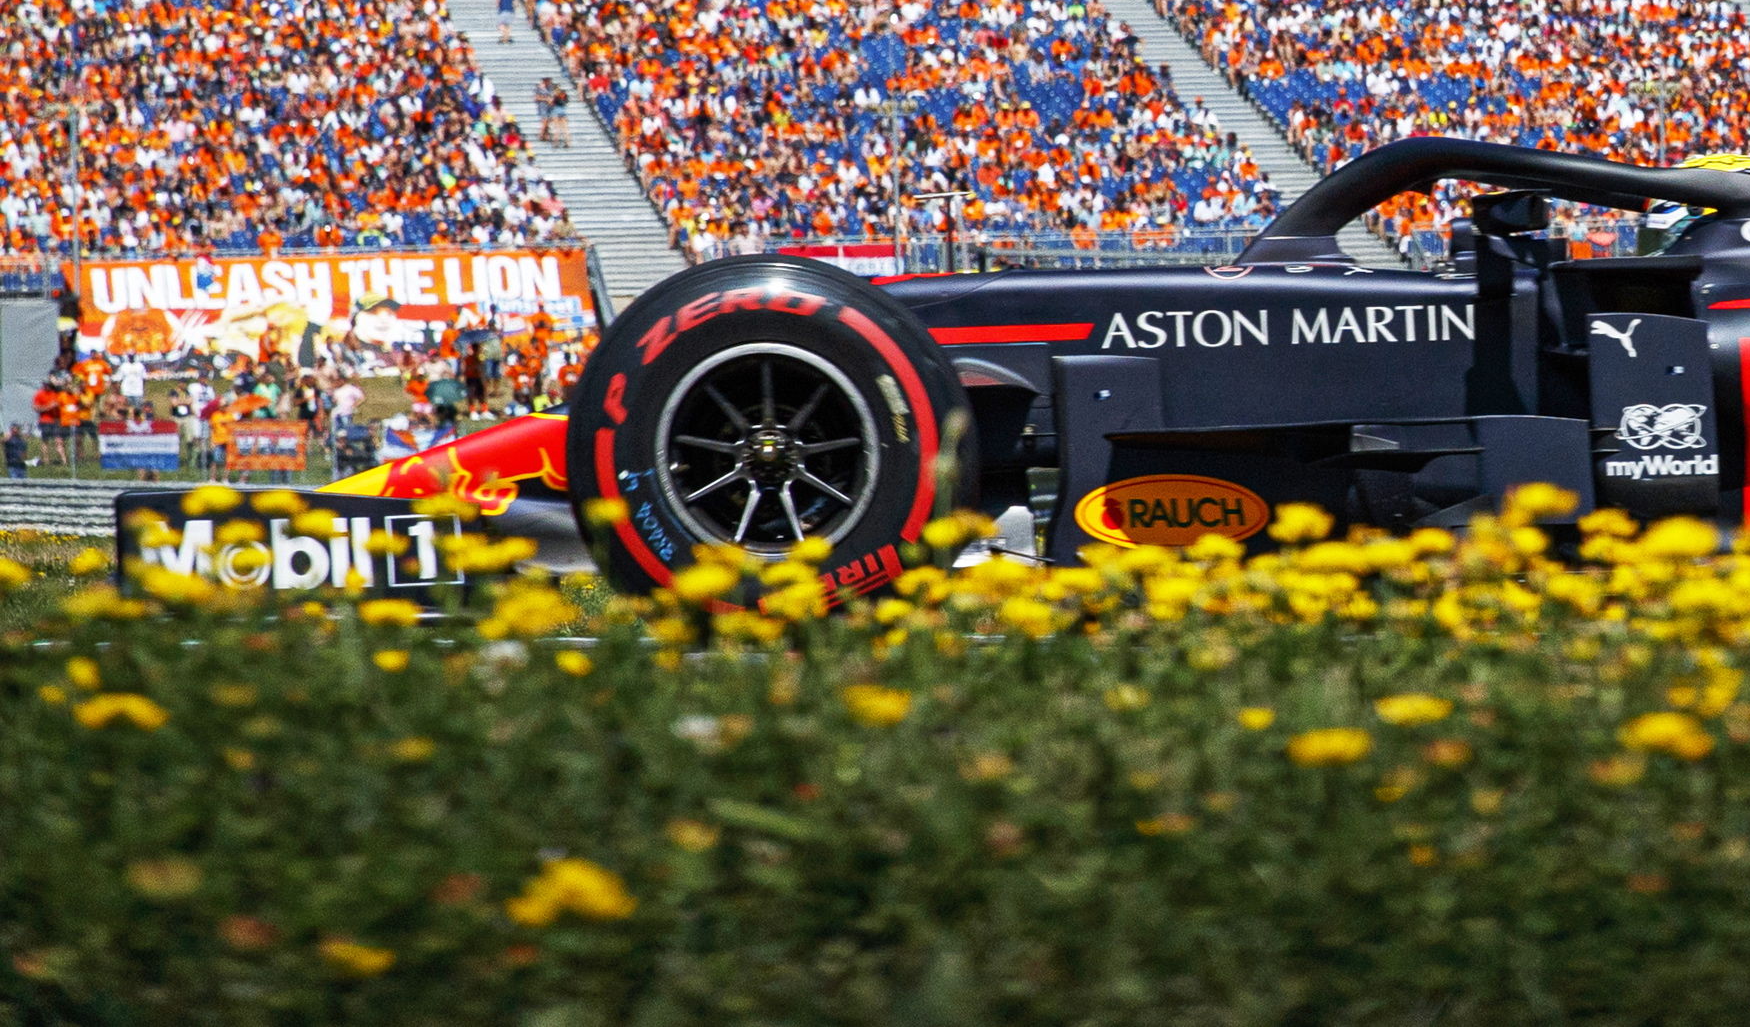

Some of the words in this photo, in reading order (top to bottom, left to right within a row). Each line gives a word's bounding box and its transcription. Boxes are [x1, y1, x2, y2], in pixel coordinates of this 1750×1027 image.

[90, 260, 333, 321] UNLEASH
[339, 257, 440, 307] THE
[443, 255, 562, 305] LION
[636, 286, 827, 365] ZERO
[1101, 309, 1270, 350] ASTON
[1291, 304, 1475, 345] MARTIN
[1606, 454, 1719, 480] myWorld
[1128, 497, 1246, 528] RAUCH
